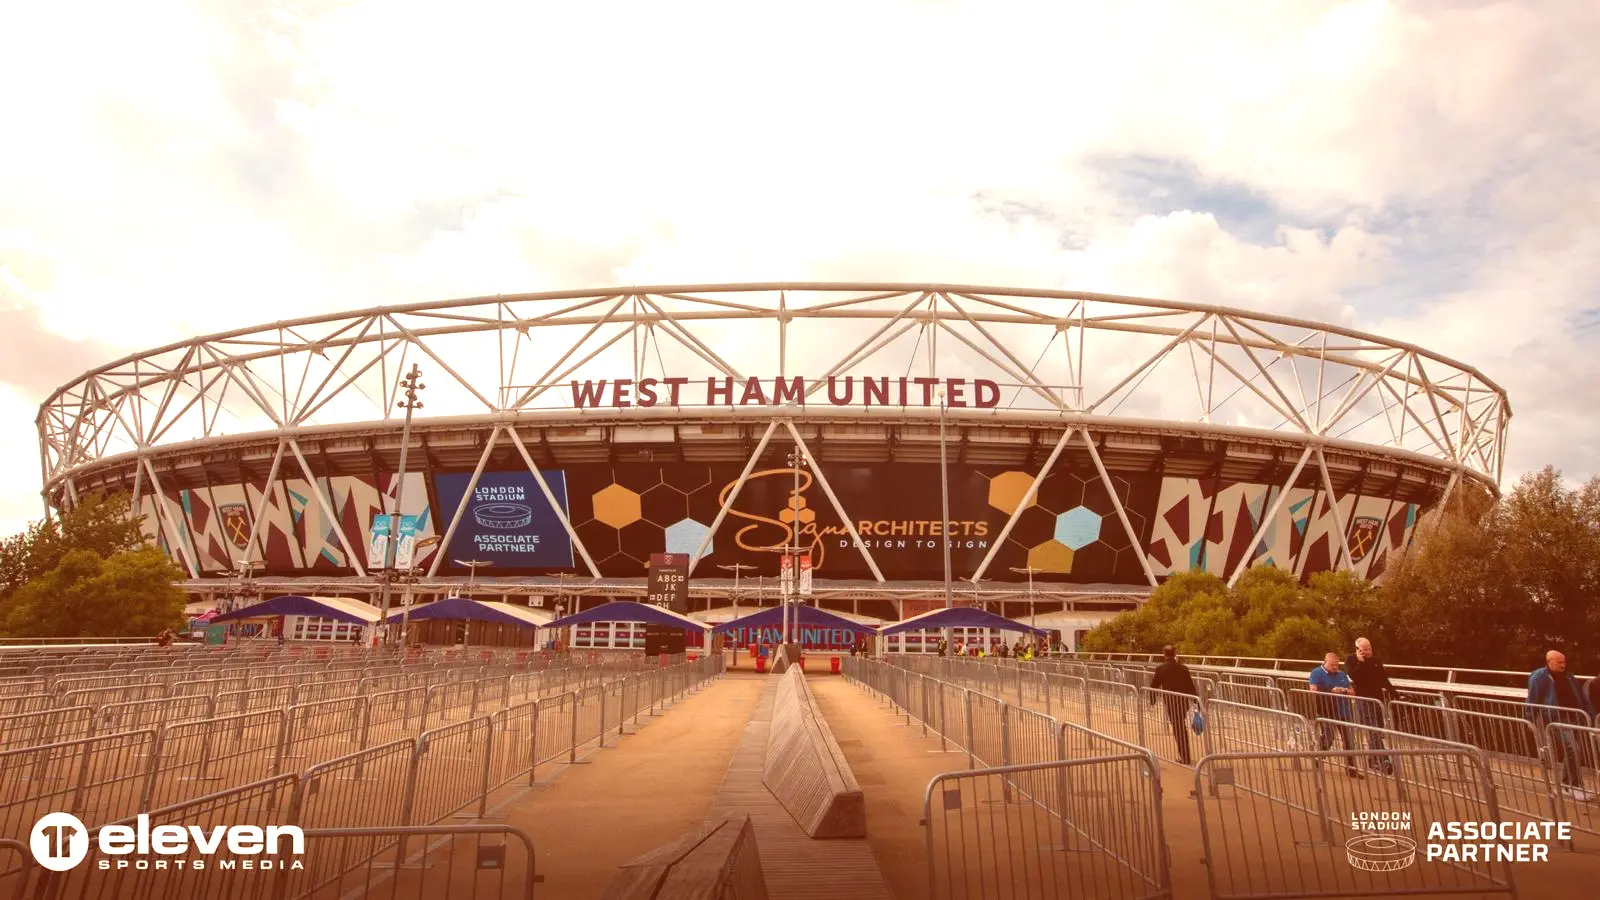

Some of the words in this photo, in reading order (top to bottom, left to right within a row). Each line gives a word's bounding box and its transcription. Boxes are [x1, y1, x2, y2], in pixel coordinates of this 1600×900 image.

[571, 377, 688, 407] WEST
[707, 376, 804, 405] HAM
[827, 376, 1000, 408] UNITED
[719, 468, 848, 570] Sgn
[474, 535, 540, 543] ASSOCIATE
[479, 543, 535, 552] PARTNER
[916, 540, 936, 549] TO
